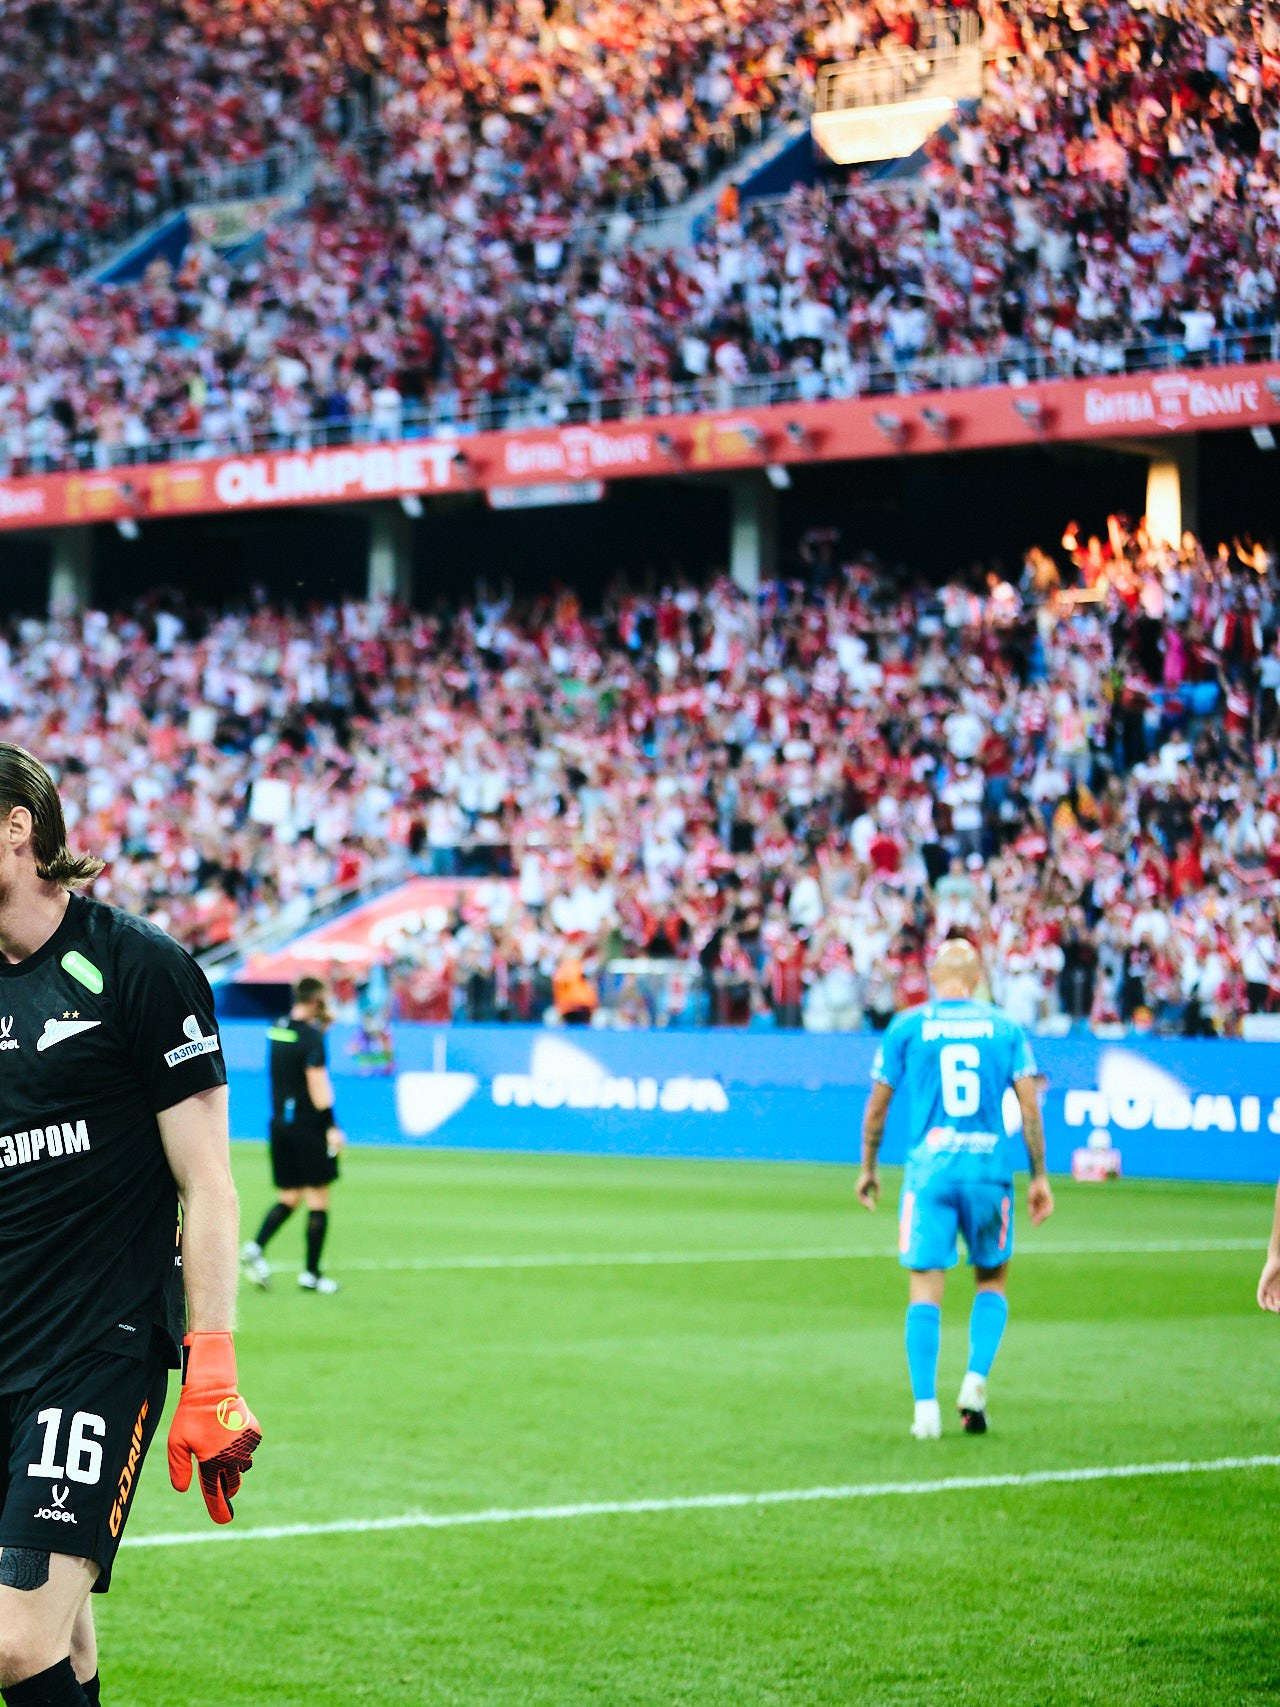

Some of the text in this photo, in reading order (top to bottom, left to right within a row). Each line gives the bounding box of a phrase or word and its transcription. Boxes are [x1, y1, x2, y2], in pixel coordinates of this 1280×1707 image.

[216, 444, 459, 505] OLIMPBET
[940, 1043, 980, 1118] 6
[27, 1407, 106, 1485] 16
